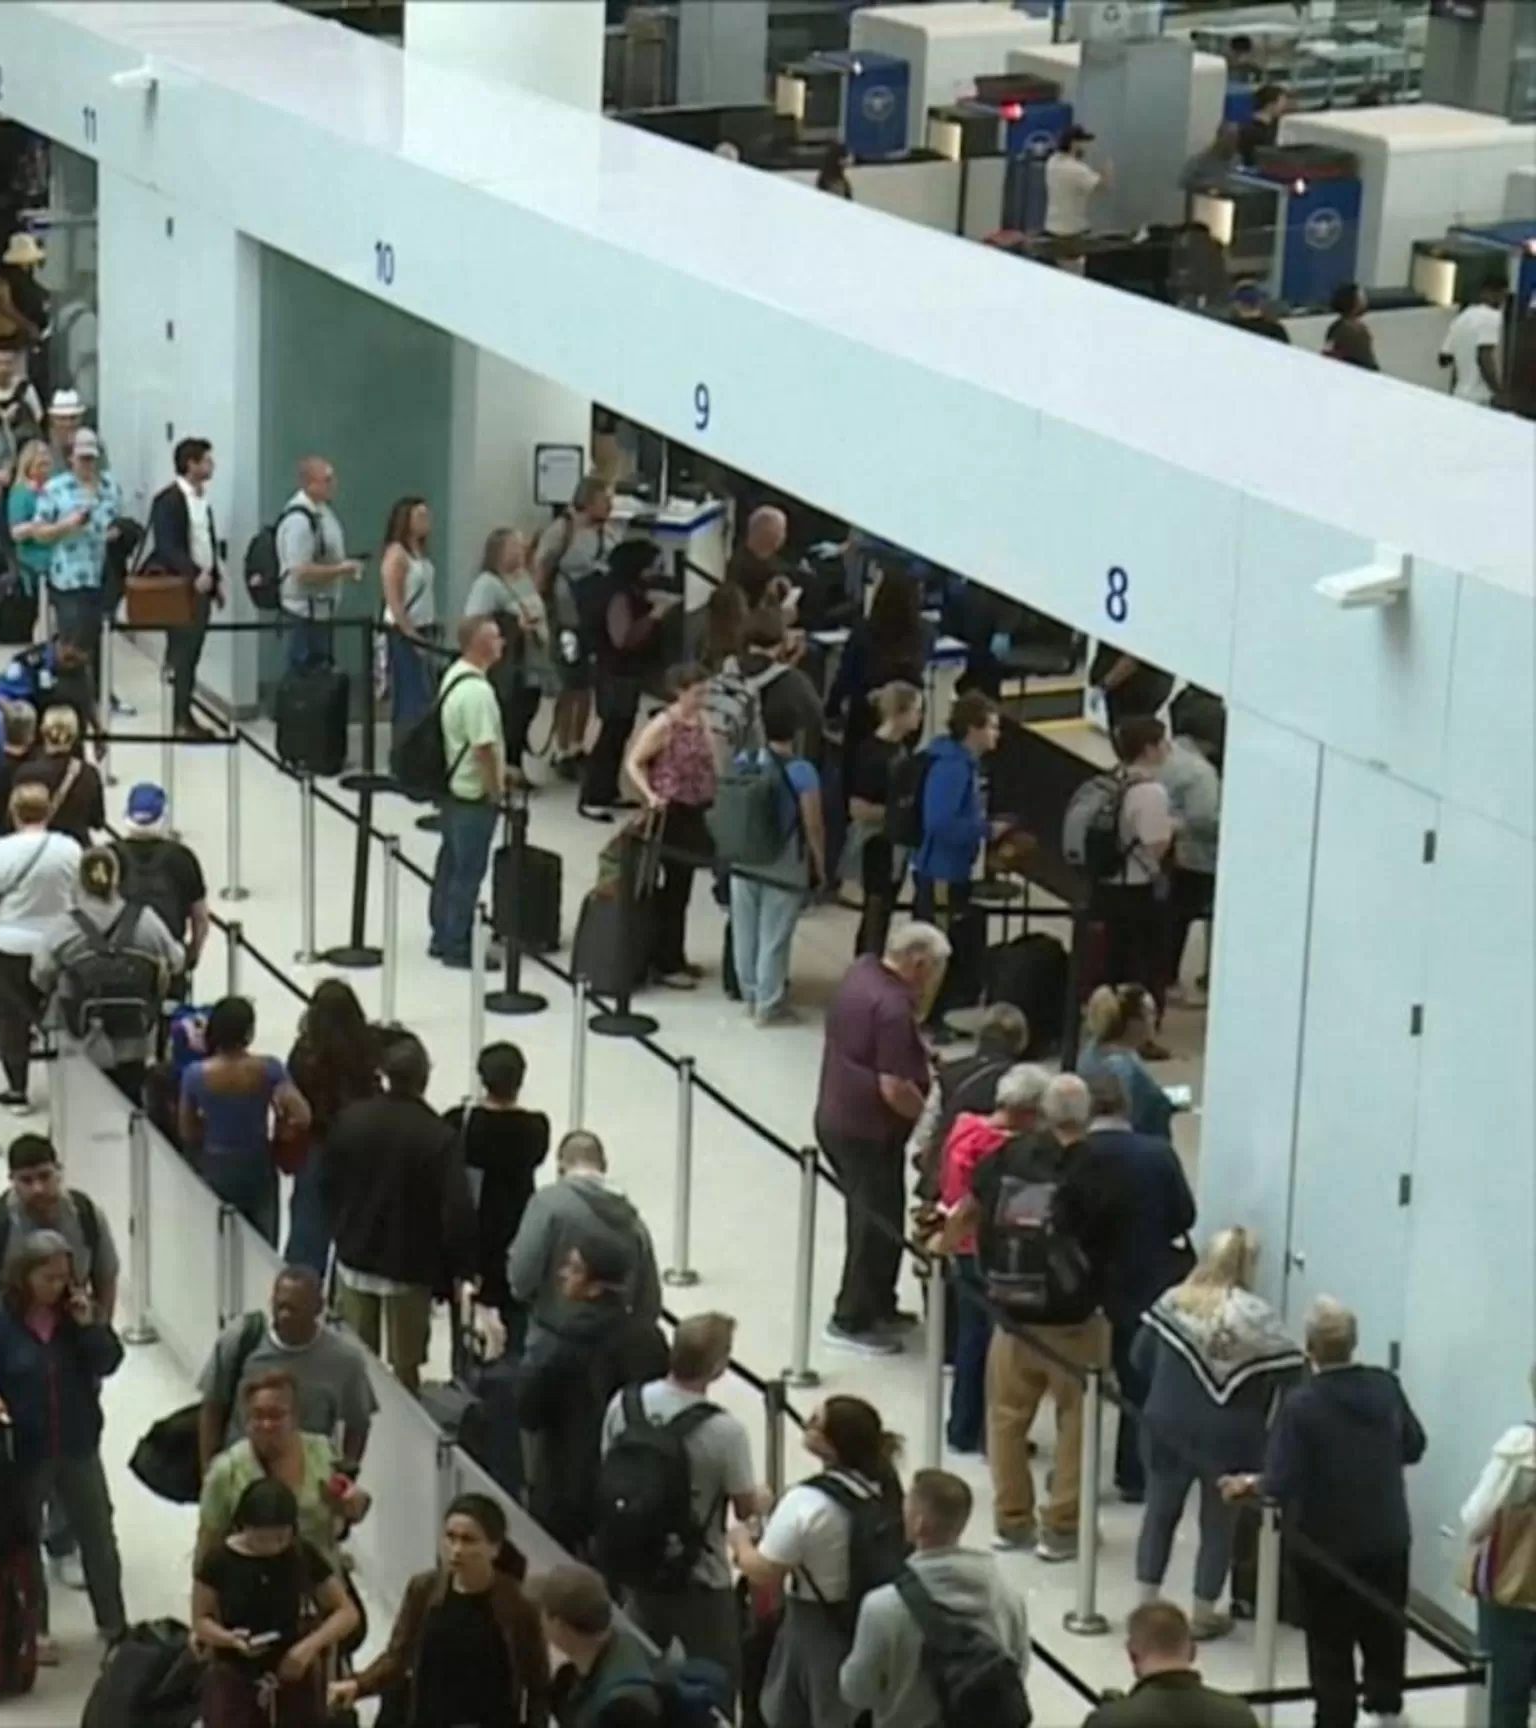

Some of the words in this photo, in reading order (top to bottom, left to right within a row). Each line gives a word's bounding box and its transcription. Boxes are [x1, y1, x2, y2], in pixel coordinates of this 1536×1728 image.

[82, 106, 96, 143] 11
[375, 240, 395, 285] 10
[695, 382, 710, 430] 9
[1106, 566, 1128, 622] 8
